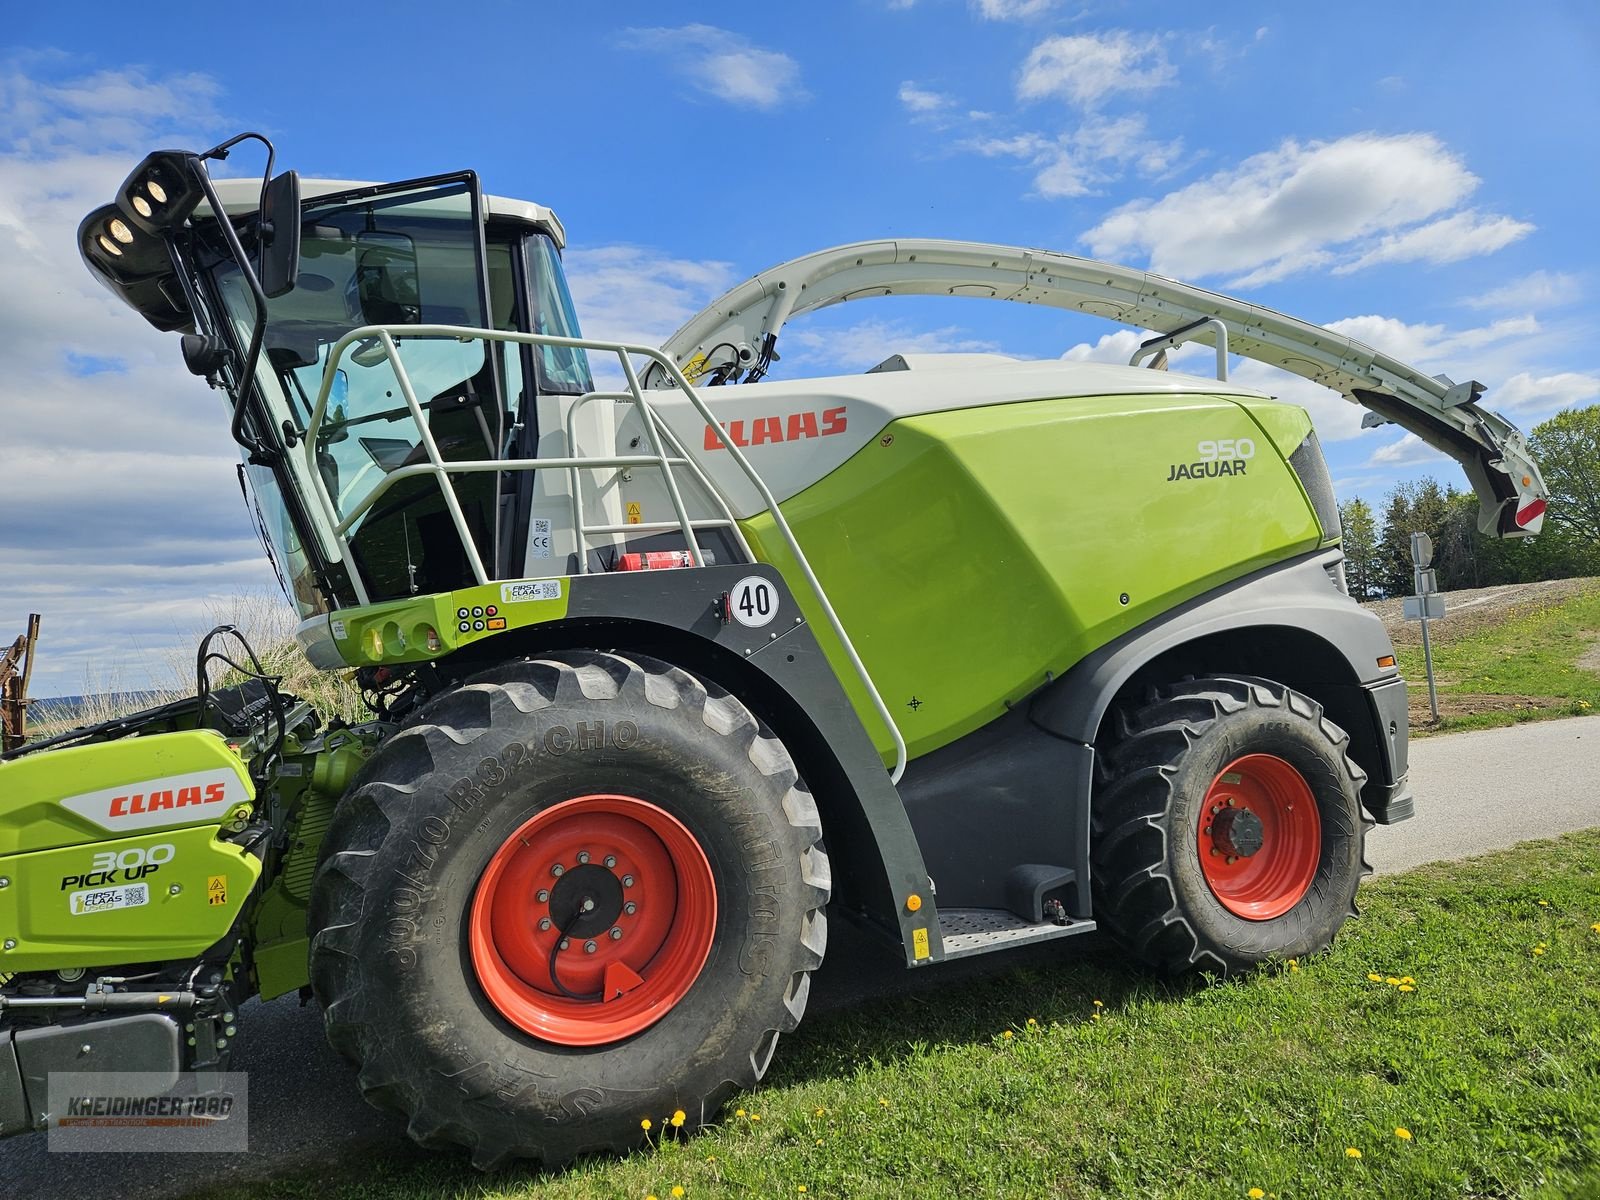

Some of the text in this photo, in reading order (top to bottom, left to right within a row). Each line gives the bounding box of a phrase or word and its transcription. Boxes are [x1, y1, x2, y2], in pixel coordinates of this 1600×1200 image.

[704, 407, 847, 451] CLAAS
[1197, 438, 1255, 462] 950
[1167, 460, 1246, 481] JAGUAR
[512, 584, 537, 592] FIRST
[512, 588, 541, 597] CLAAS
[739, 584, 770, 617] 40
[544, 719, 640, 756] CHO
[109, 783, 225, 818] CLAAS
[91, 844, 176, 873] 300
[60, 864, 160, 891] PICK UP
[84, 895, 123, 906] CLAAS
[84, 902, 114, 912] USED
[85, 890, 117, 900] FIRST
